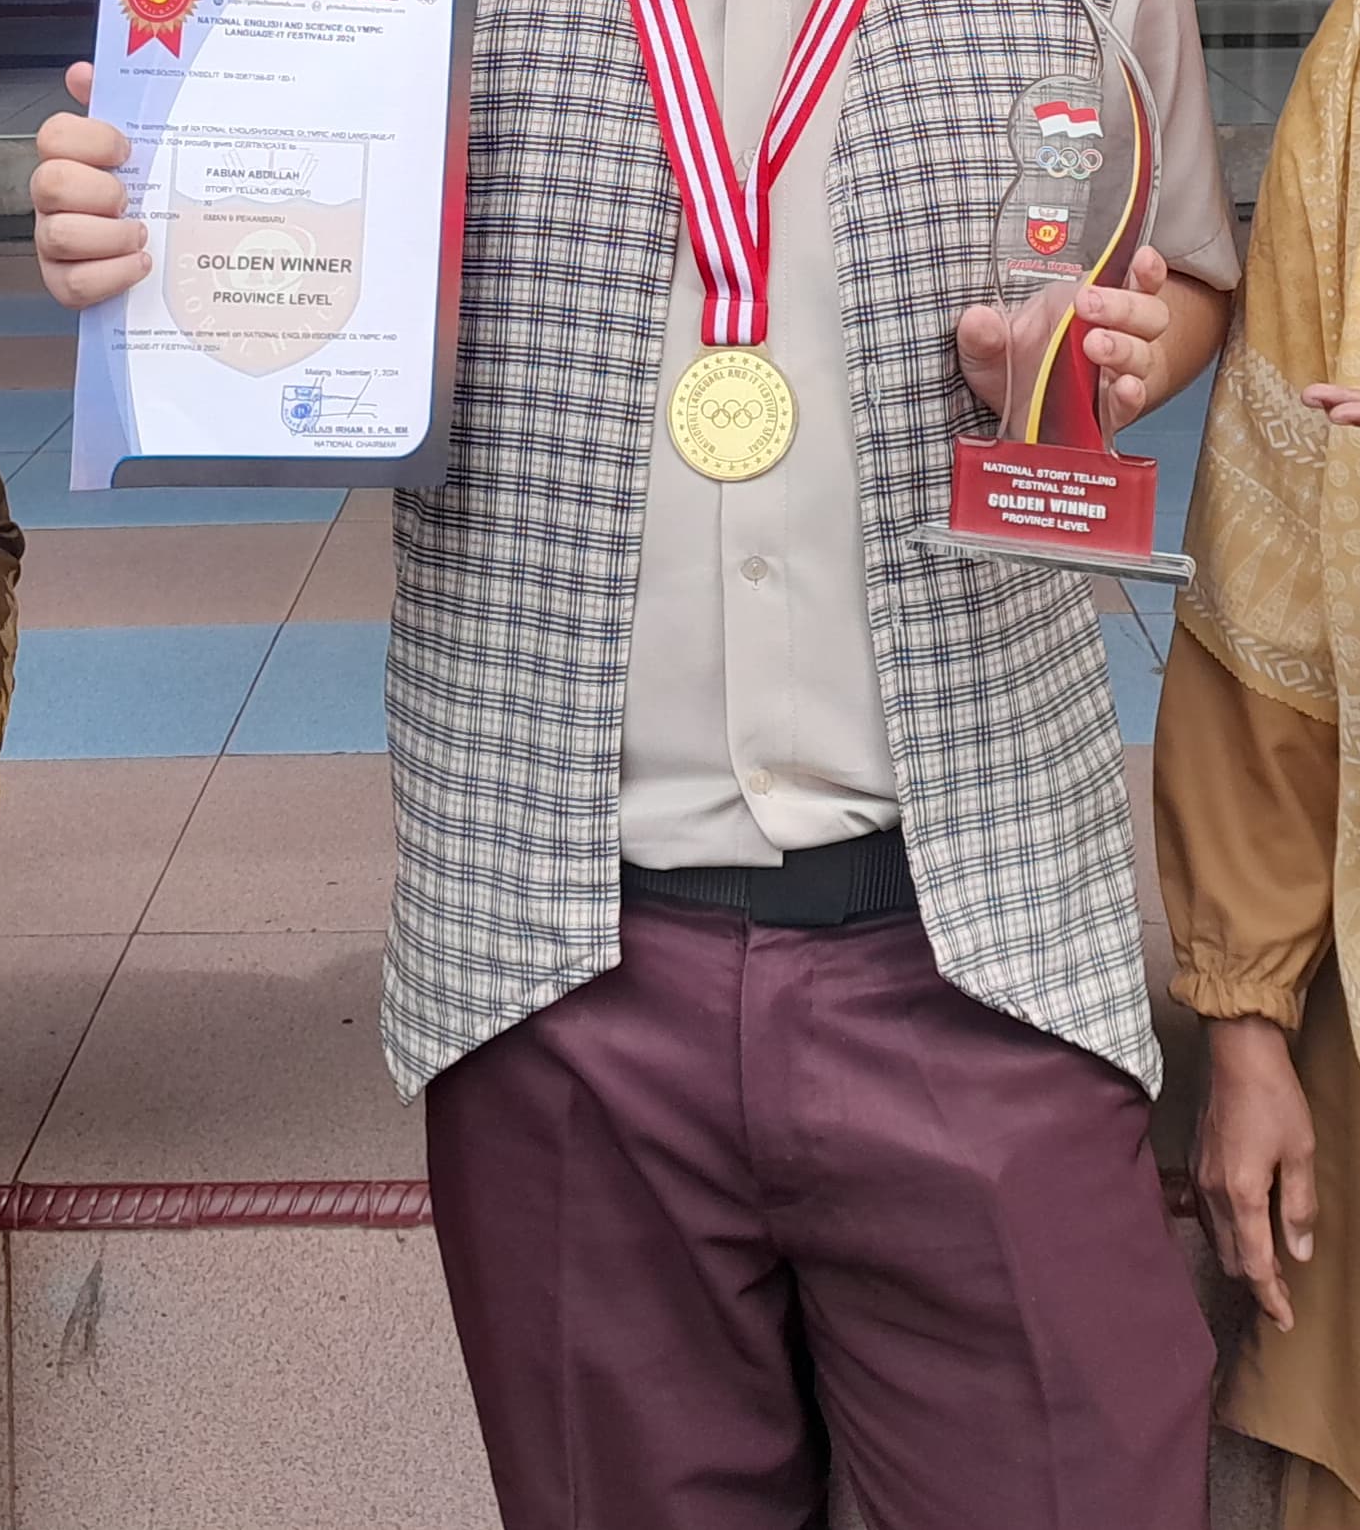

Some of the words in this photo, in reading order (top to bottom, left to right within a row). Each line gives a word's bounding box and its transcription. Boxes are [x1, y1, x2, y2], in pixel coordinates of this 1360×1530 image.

[198, 16, 241, 26] NATIONAL
[244, 19, 284, 28] ENGLISH
[285, 21, 303, 30] AND
[305, 22, 343, 32] SCIENCE
[345, 24, 384, 34] OLYMPIC
[225, 28, 285, 38] LANGUAGE-IT
[287, 31, 333, 41] FESTIVALS
[335, 34, 356, 42] 2024
[206, 168, 245, 178] FABIAN
[248, 170, 300, 180] ABDILLAH
[197, 254, 275, 271] GOLDEN
[281, 257, 352, 273] WINNER
[213, 291, 285, 305] PROVINCE
[289, 294, 332, 306] LEVEL
[983, 461, 1034, 478] NATIONAL
[1036, 468, 1071, 481] STORY
[1073, 472, 1117, 487] TELLING
[1012, 478, 1059, 493] FESTIVAL
[1062, 485, 1085, 496] 2024
[988, 493, 1045, 512] GOLDEN
[1050, 498, 1106, 519] WINNER
[1002, 512, 1055, 527] PROVINCE
[1057, 520, 1090, 532] LEVEL
